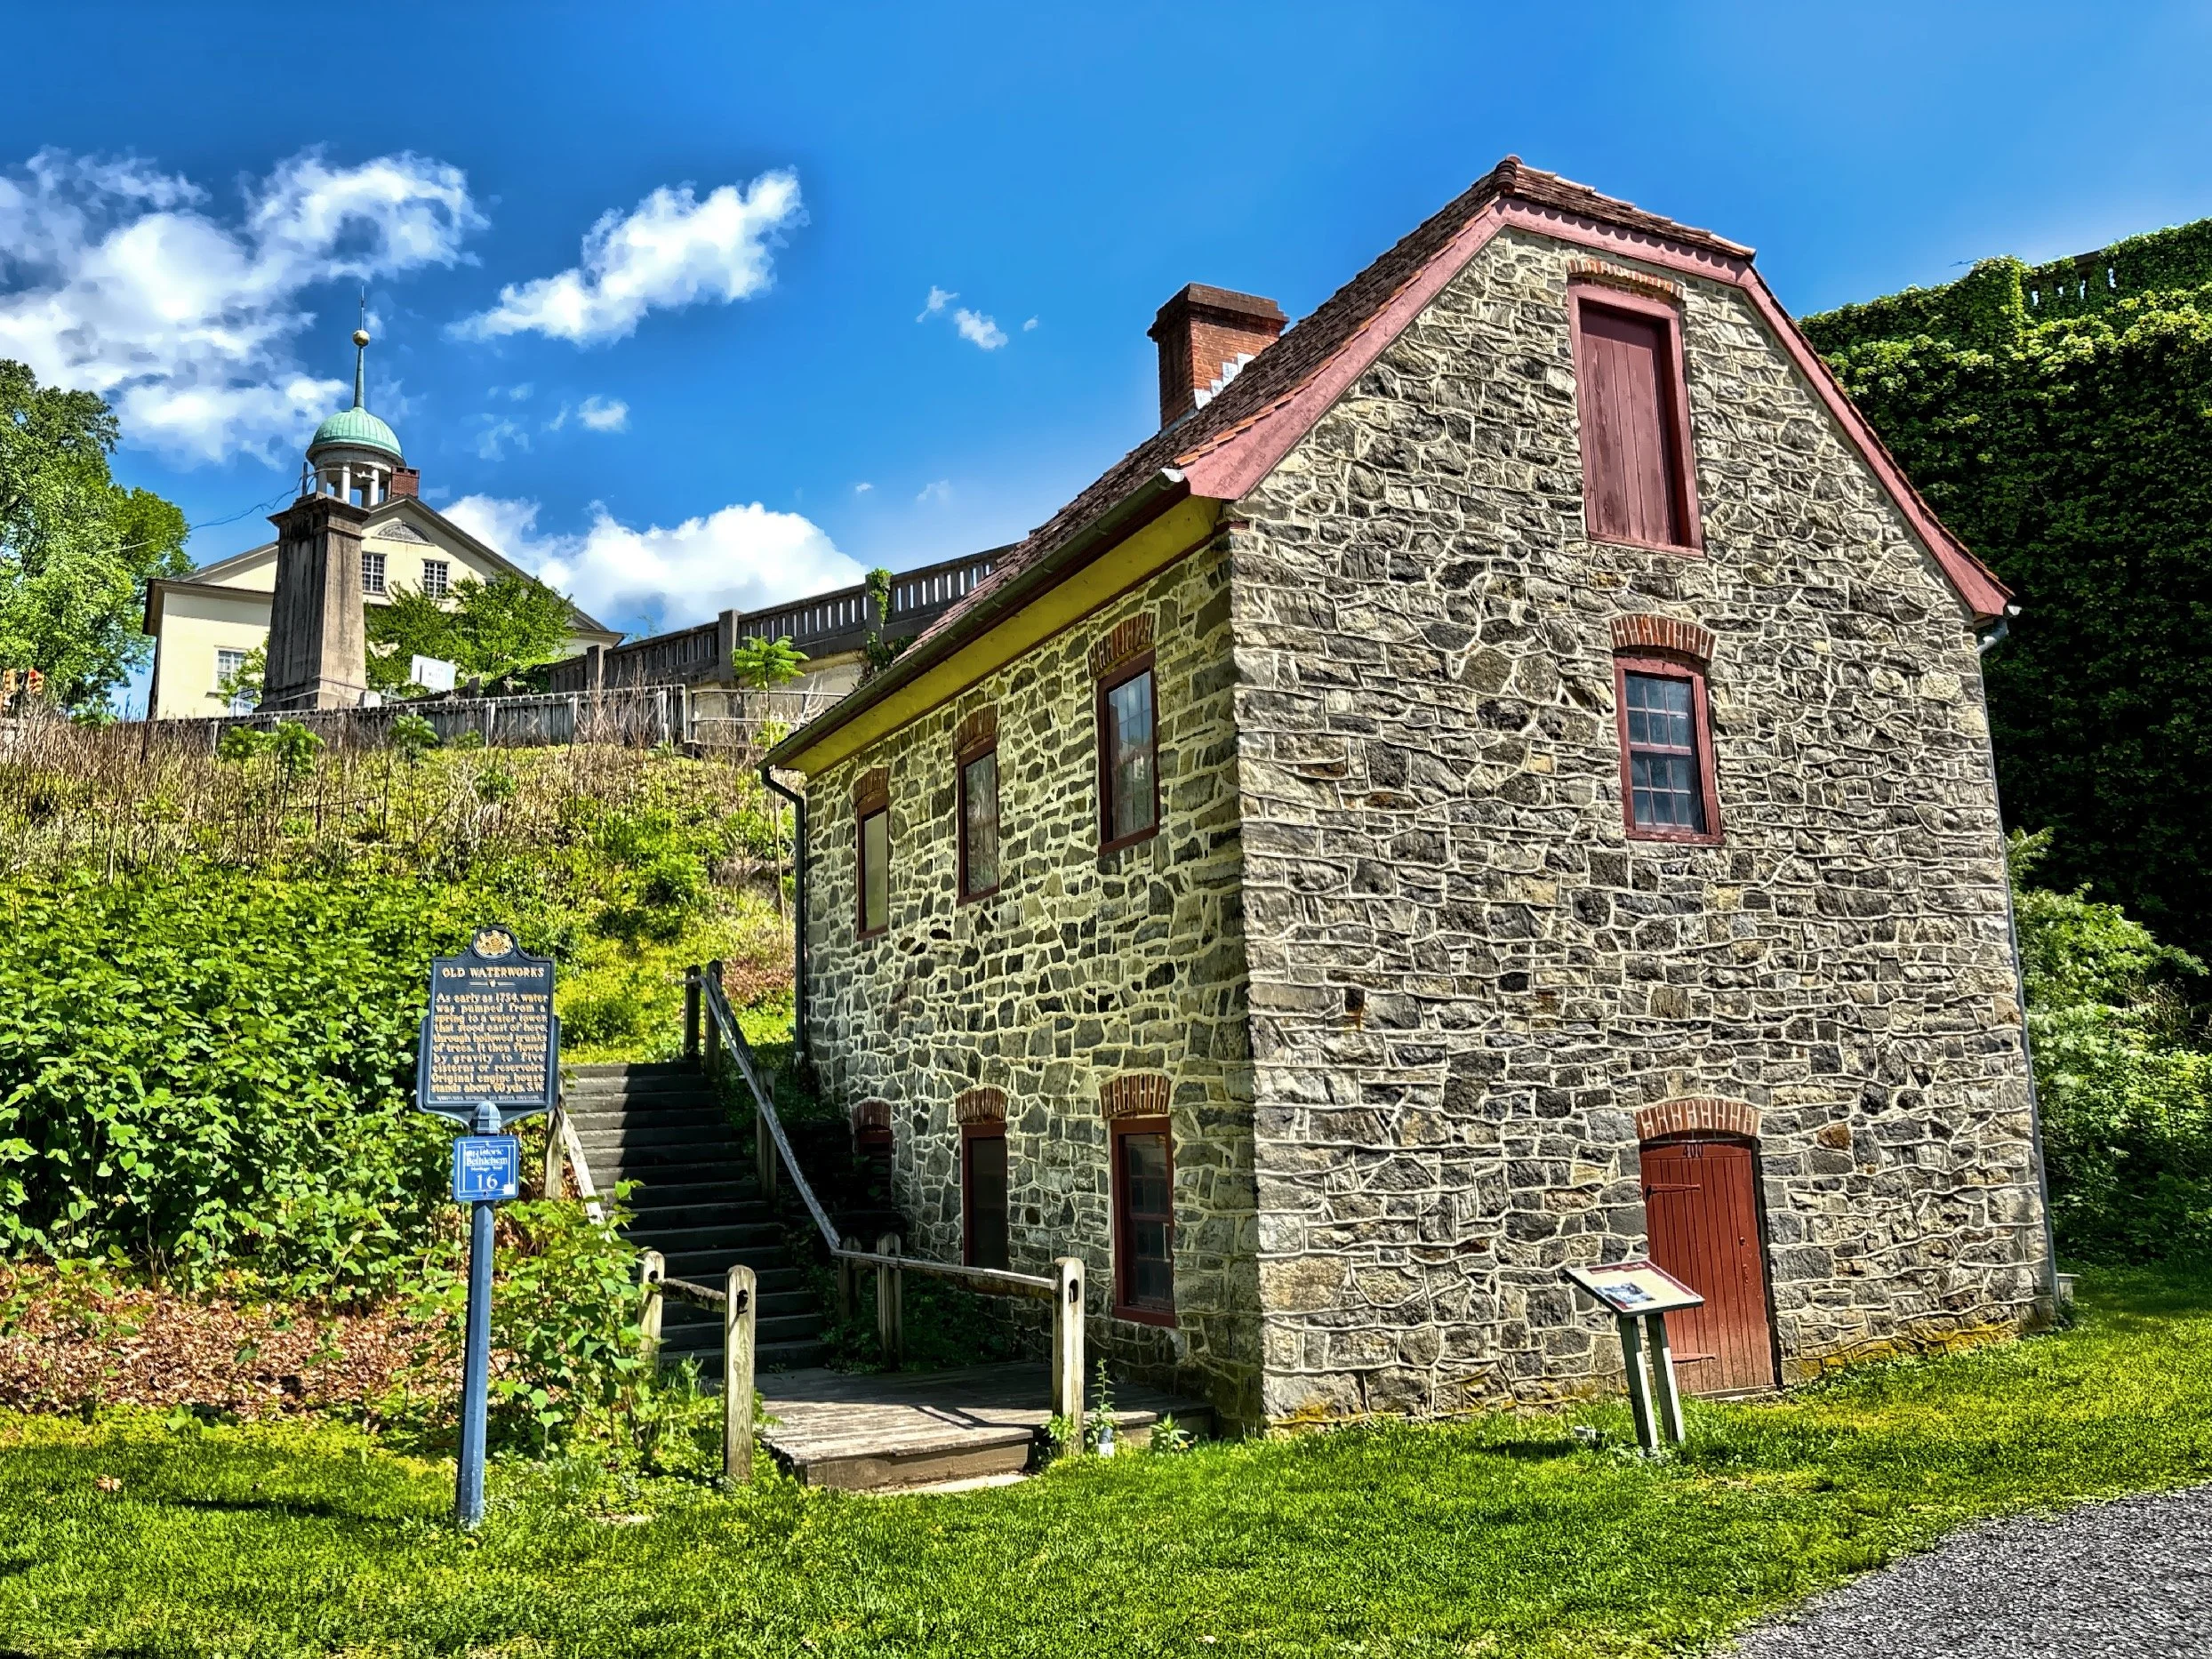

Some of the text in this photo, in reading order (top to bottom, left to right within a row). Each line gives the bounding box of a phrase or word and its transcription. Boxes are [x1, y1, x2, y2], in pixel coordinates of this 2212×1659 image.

[442, 966, 545, 978] OLD WATERWORKS
[436, 992, 451, 1003] As
[453, 992, 480, 1005] early
[482, 994, 493, 1003] as
[520, 993, 549, 1003] water
[436, 1002, 546, 1014] was pumped from a
[434, 1013, 465, 1025] spring
[468, 1014, 478, 1022] to
[489, 1014, 517, 1022] water
[434, 1022, 453, 1032] that
[457, 1022, 485, 1032] stood
[486, 1023, 507, 1032] east
[509, 1022, 522, 1032] of
[434, 1032, 471, 1044] through
[472, 1032, 513, 1043] hollowed
[432, 1043, 445, 1052] of
[477, 1042, 486, 1052] It
[487, 1042, 510, 1052] then
[514, 1042, 547, 1052] flowed
[433, 1053, 546, 1065] by gravity to five
[432, 1062, 475, 1072] cisterns
[477, 1064, 490, 1072] or
[430, 1071, 545, 1085] Original engine house
[430, 1083, 461, 1093] stands
[463, 1083, 491, 1093] about
[493, 1083, 506, 1093] 60
[467, 1157, 508, 1166] Bethlehem
[476, 1173, 499, 1190] 16
